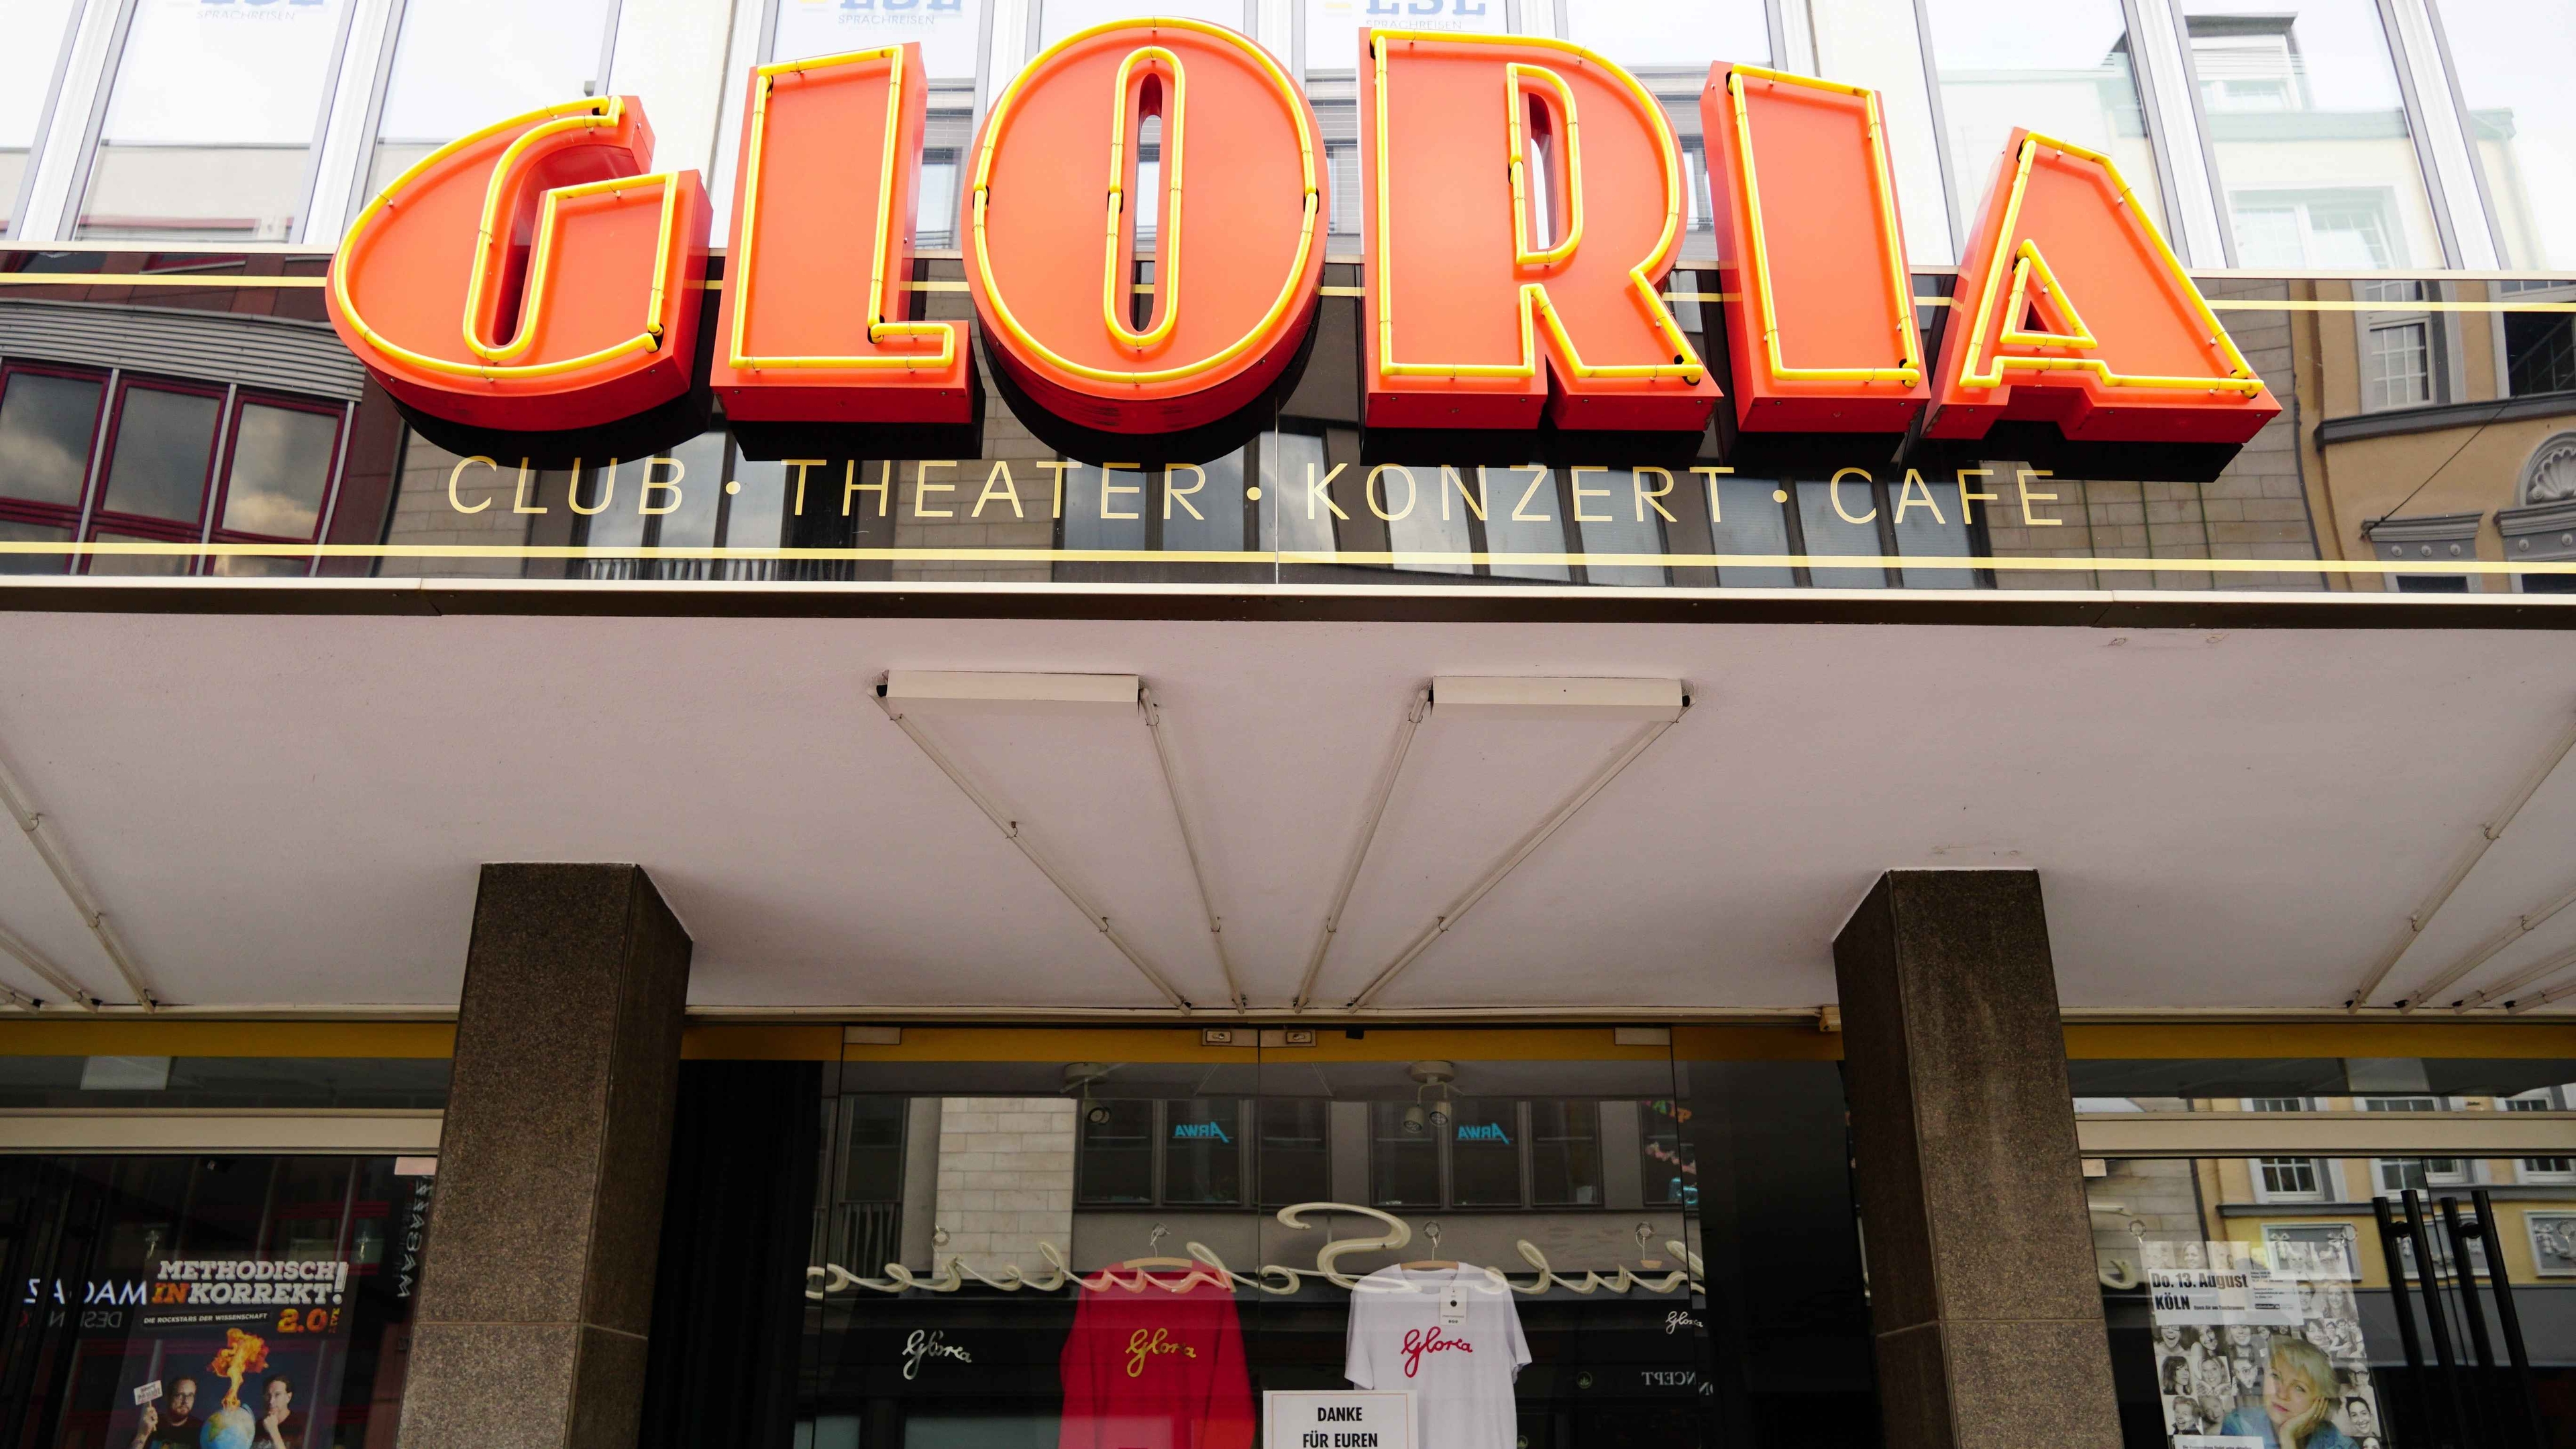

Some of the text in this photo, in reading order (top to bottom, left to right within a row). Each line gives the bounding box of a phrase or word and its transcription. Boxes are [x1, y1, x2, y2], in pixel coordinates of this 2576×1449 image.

[839, 15, 934, 25] SPRACHREISEN
[326, 18, 2281, 437] GLORIA
[448, 455, 2063, 525] CLUB THEATER KONZERT CAFE
[158, 1260, 337, 1281] METHODISCH
[2151, 1273, 2174, 1288] Do.
[2176, 1273, 2196, 1288] 13.
[2199, 1273, 2249, 1290] August
[2155, 1292, 2190, 1310] KÖLN
[215, 1312, 268, 1321] WISSENSCHAFT
[277, 1308, 328, 1333] 2.0
[1317, 1407, 1363, 1422] DANKE
[1302, 1430, 1379, 1448] FÜR EUREN
